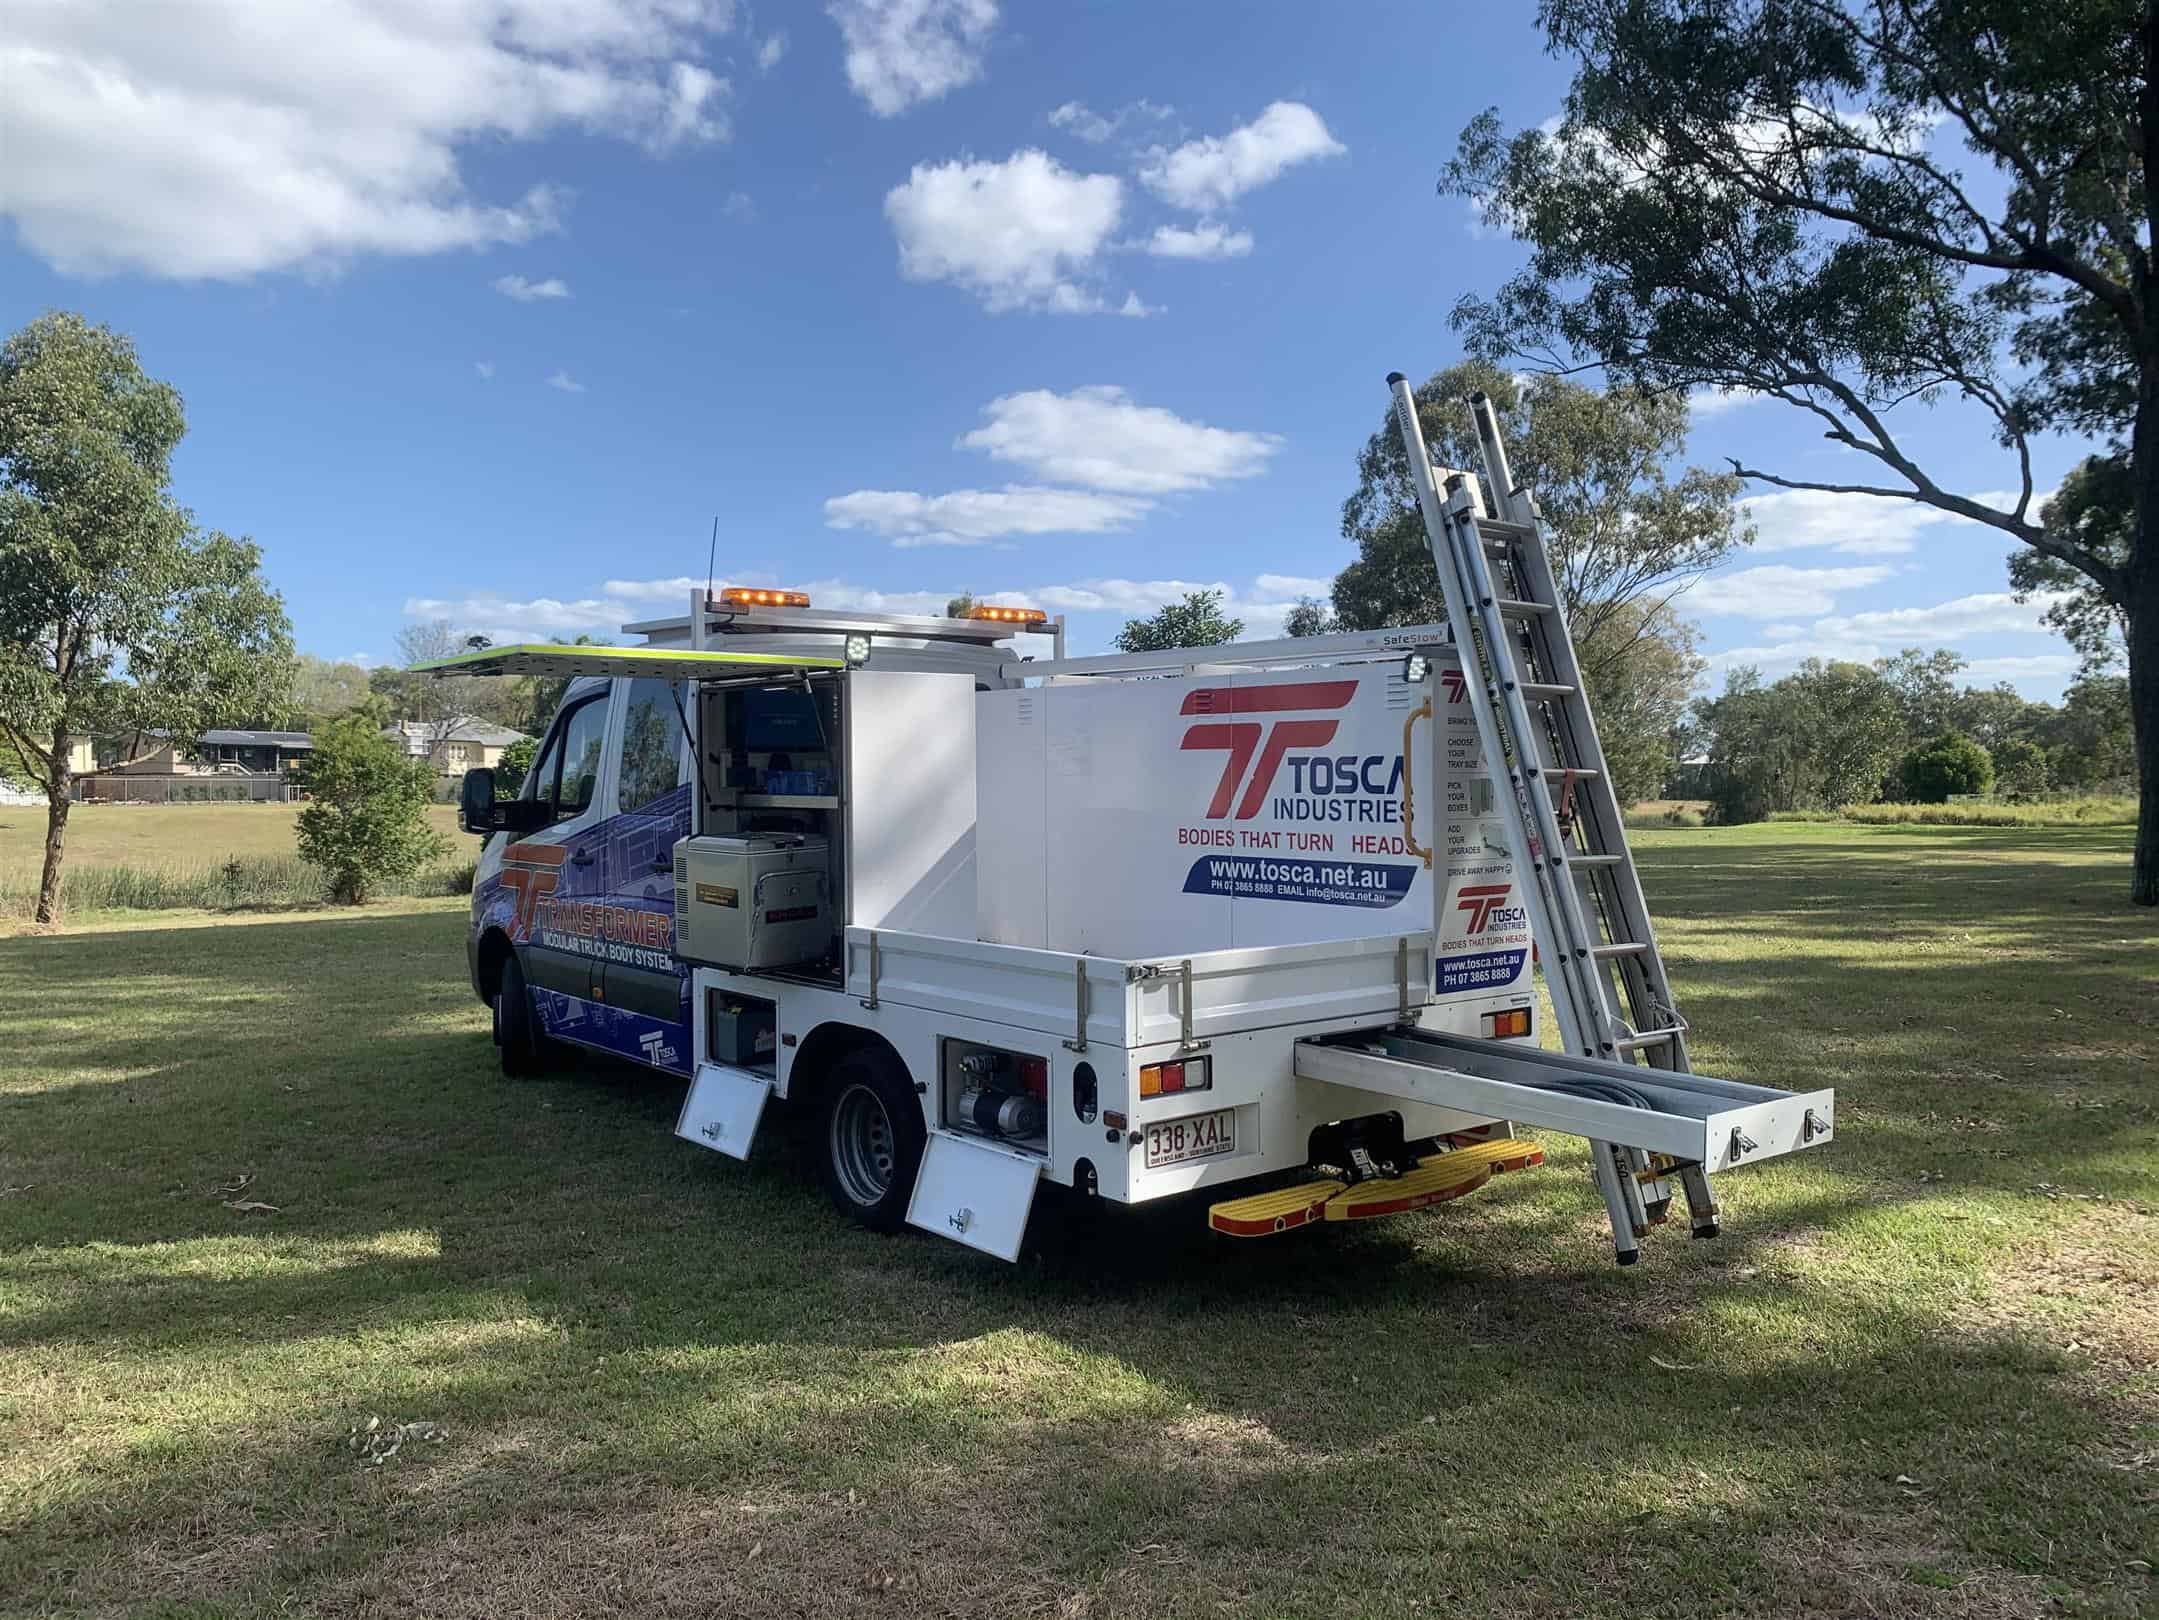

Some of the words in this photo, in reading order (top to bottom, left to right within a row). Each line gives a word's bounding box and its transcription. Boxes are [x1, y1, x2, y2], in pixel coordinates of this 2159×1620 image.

[1448, 738, 1474, 747] CHOOSE
[1448, 749, 1465, 758] YOUR
[1448, 760, 1464, 769] TRAY
[1287, 755, 1414, 796] TOSCA
[1448, 792, 1465, 801] YOUR
[1274, 798, 1415, 824] INDUSTRIES
[1448, 825, 1461, 833] ADD
[1179, 828, 1235, 847] BODIES
[1240, 830, 1281, 849] THAT
[1286, 832, 1335, 852] TURN
[1448, 836, 1465, 844] YOUR
[1448, 846, 1481, 856] UPGRADES
[1209, 859, 1388, 889] www.tosca.net.au
[1485, 864, 1504, 874] HAPPY
[1211, 879, 1223, 889] PH
[1277, 884, 1305, 896] EMAIL
[1306, 886, 1385, 903] info@tosca.net.au
[1492, 907, 1526, 923] TOSCA
[537, 898, 671, 951] TRANSFORMER
[1488, 920, 1527, 932] INDUSTRIES
[542, 930, 580, 953] MODULAR
[579, 939, 607, 957] TRUCK
[609, 944, 634, 964] BODY
[635, 949, 674, 971] SYSTEM
[1442, 940, 1467, 951] BODIES
[1468, 938, 1485, 947] THAT
[1486, 936, 1504, 945] TURN
[1505, 934, 1528, 944] HEADS
[1443, 955, 1520, 972] www.tosca.net.au
[1444, 975, 1457, 986] PH
[1458, 973, 1468, 985] 07
[1470, 970, 1489, 982] 3865
[1491, 967, 1510, 980] 8888
